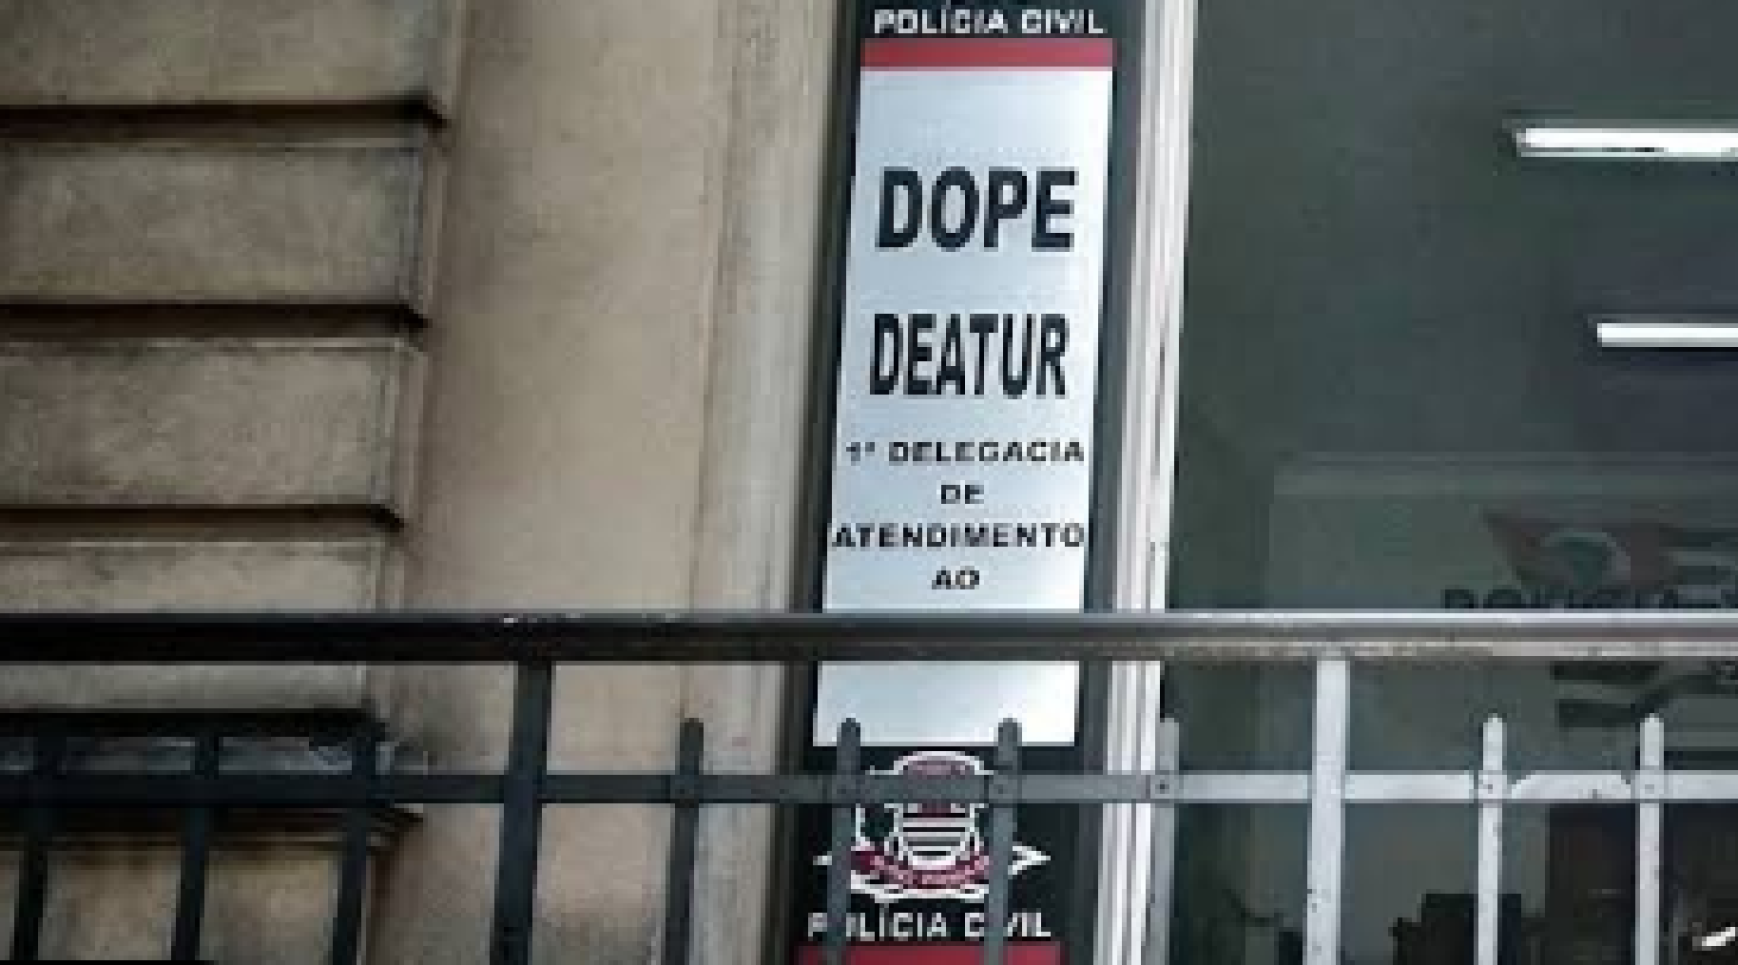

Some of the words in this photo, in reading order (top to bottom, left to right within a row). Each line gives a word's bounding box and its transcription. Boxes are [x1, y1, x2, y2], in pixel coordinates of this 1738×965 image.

[1020, 8, 1104, 35] CIVIL
[875, 165, 1079, 253] DOPE
[869, 313, 1071, 399] DEATUR
[888, 440, 1086, 463] DELEGACIA
[939, 483, 985, 505] DE
[831, 523, 1086, 548] ATENDIMENTO
[931, 566, 982, 591] AO
